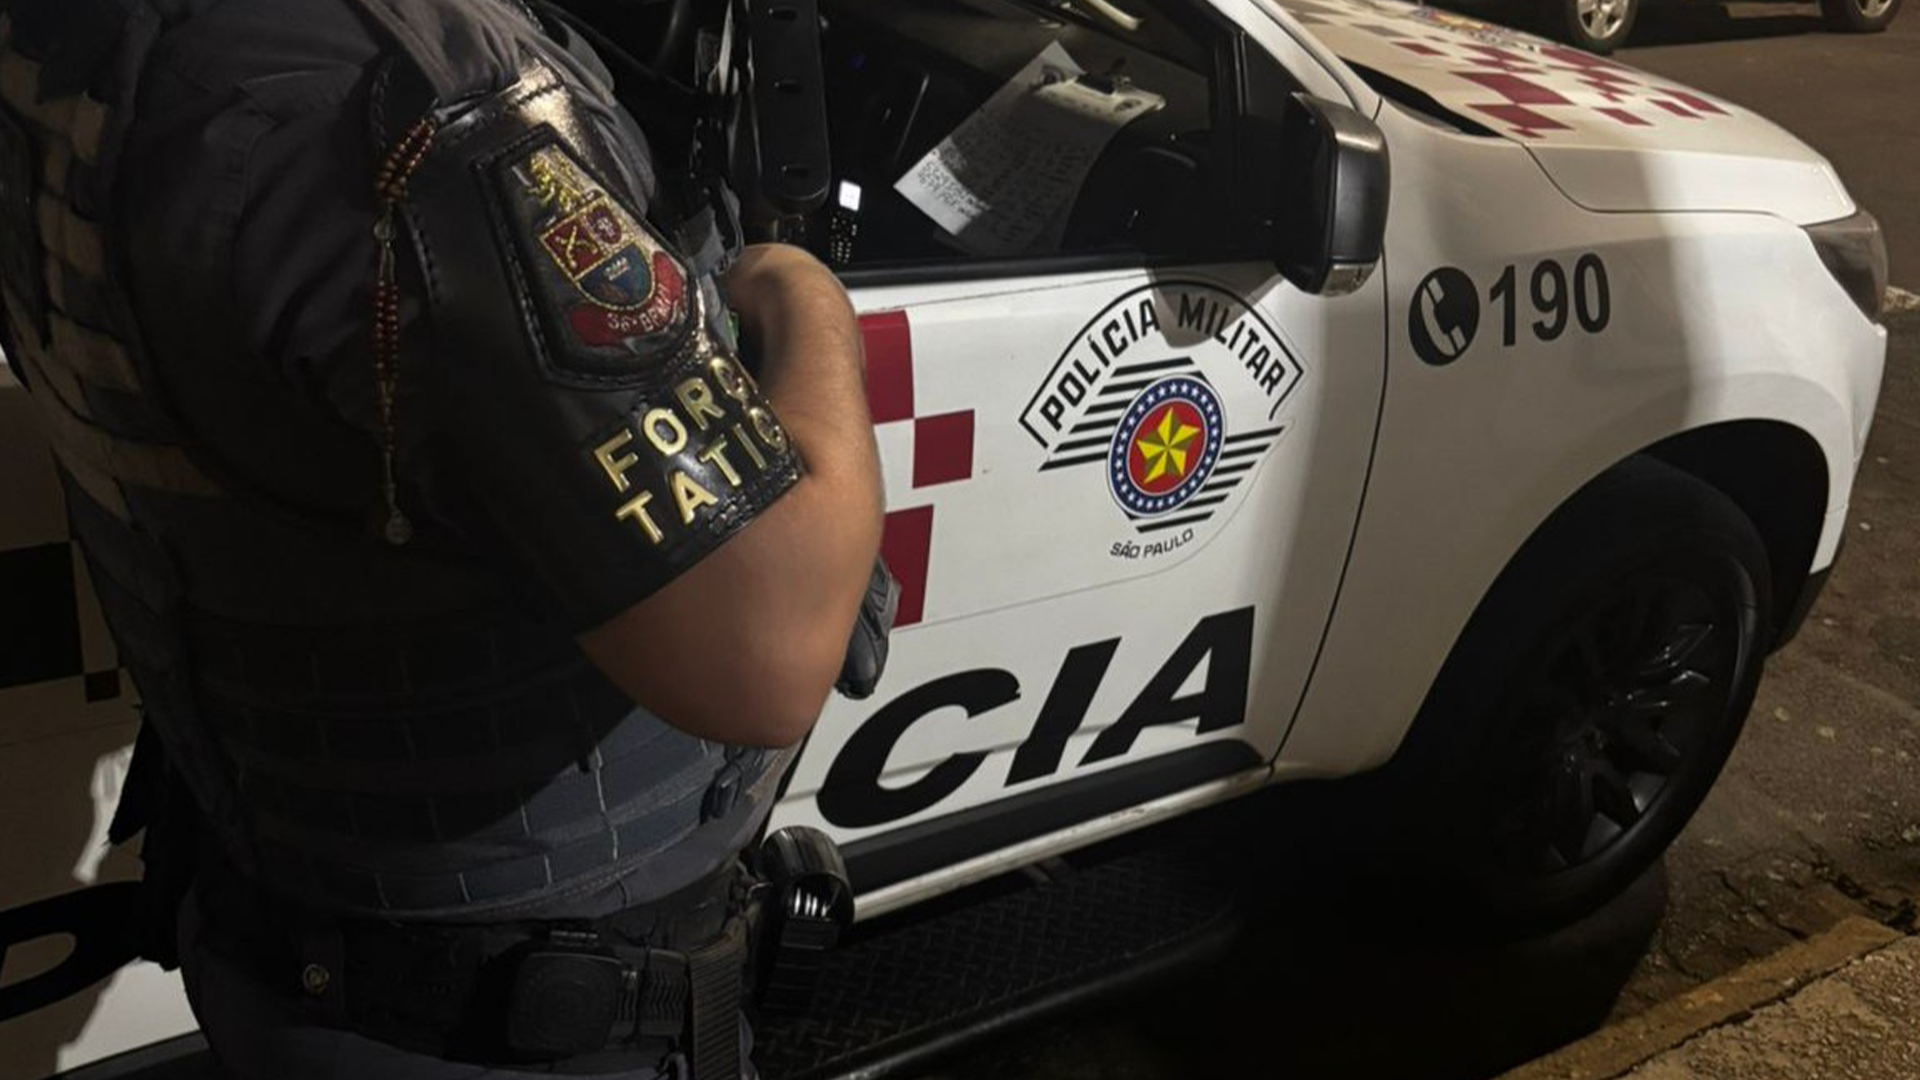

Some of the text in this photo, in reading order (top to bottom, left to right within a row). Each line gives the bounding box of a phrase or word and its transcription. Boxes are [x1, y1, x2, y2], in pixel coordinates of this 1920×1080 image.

[1039, 293, 1286, 432] POLÍCIA MILITAR
[1489, 253, 1610, 346] 190
[615, 399, 788, 544] TATIC
[1109, 528, 1195, 560] SÃO PAULO
[762, 605, 1256, 846] CIA
